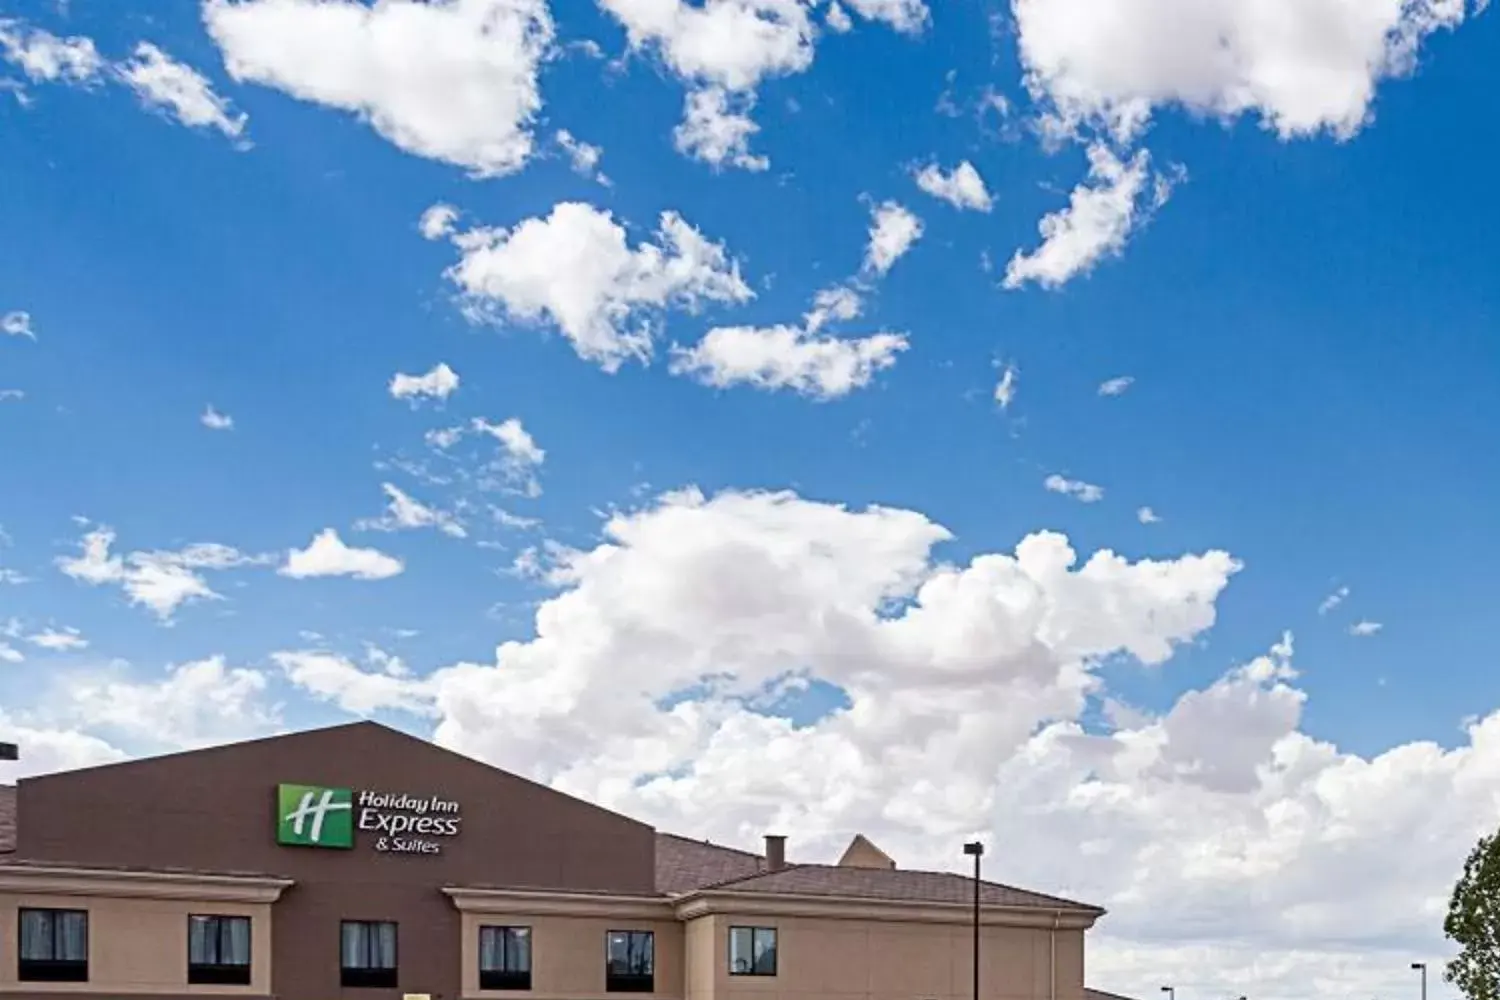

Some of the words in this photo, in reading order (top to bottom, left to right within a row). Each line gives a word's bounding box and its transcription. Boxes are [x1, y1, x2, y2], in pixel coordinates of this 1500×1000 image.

[359, 791, 429, 813] Holiday
[431, 796, 459, 813] Inn
[359, 808, 460, 836] Express
[375, 837, 389, 851] &
[392, 838, 440, 853] Suites
